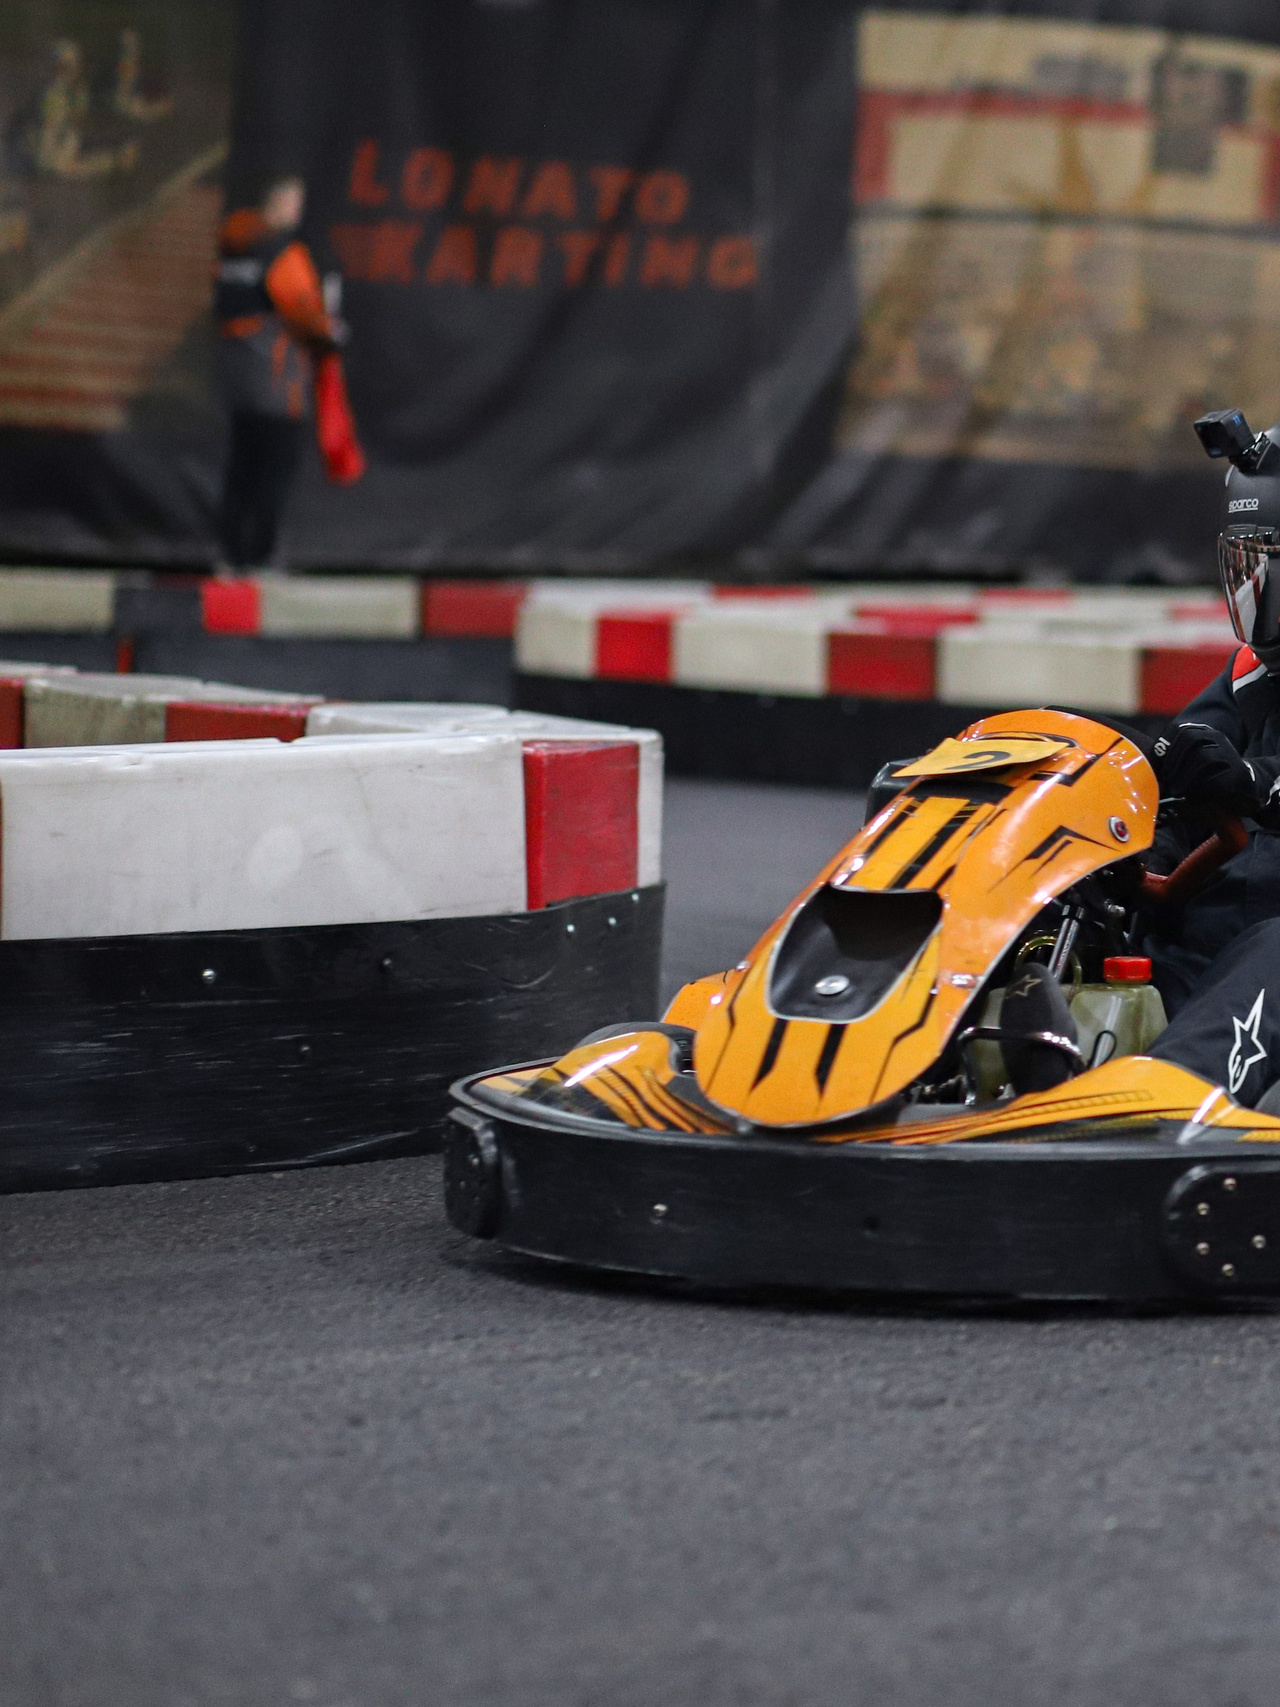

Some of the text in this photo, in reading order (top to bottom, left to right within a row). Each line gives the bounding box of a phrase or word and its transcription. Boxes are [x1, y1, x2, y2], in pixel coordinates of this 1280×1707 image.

[348, 138, 690, 226] LONATO
[328, 219, 761, 290] KARTING
[1228, 498, 1259, 511] sparco
